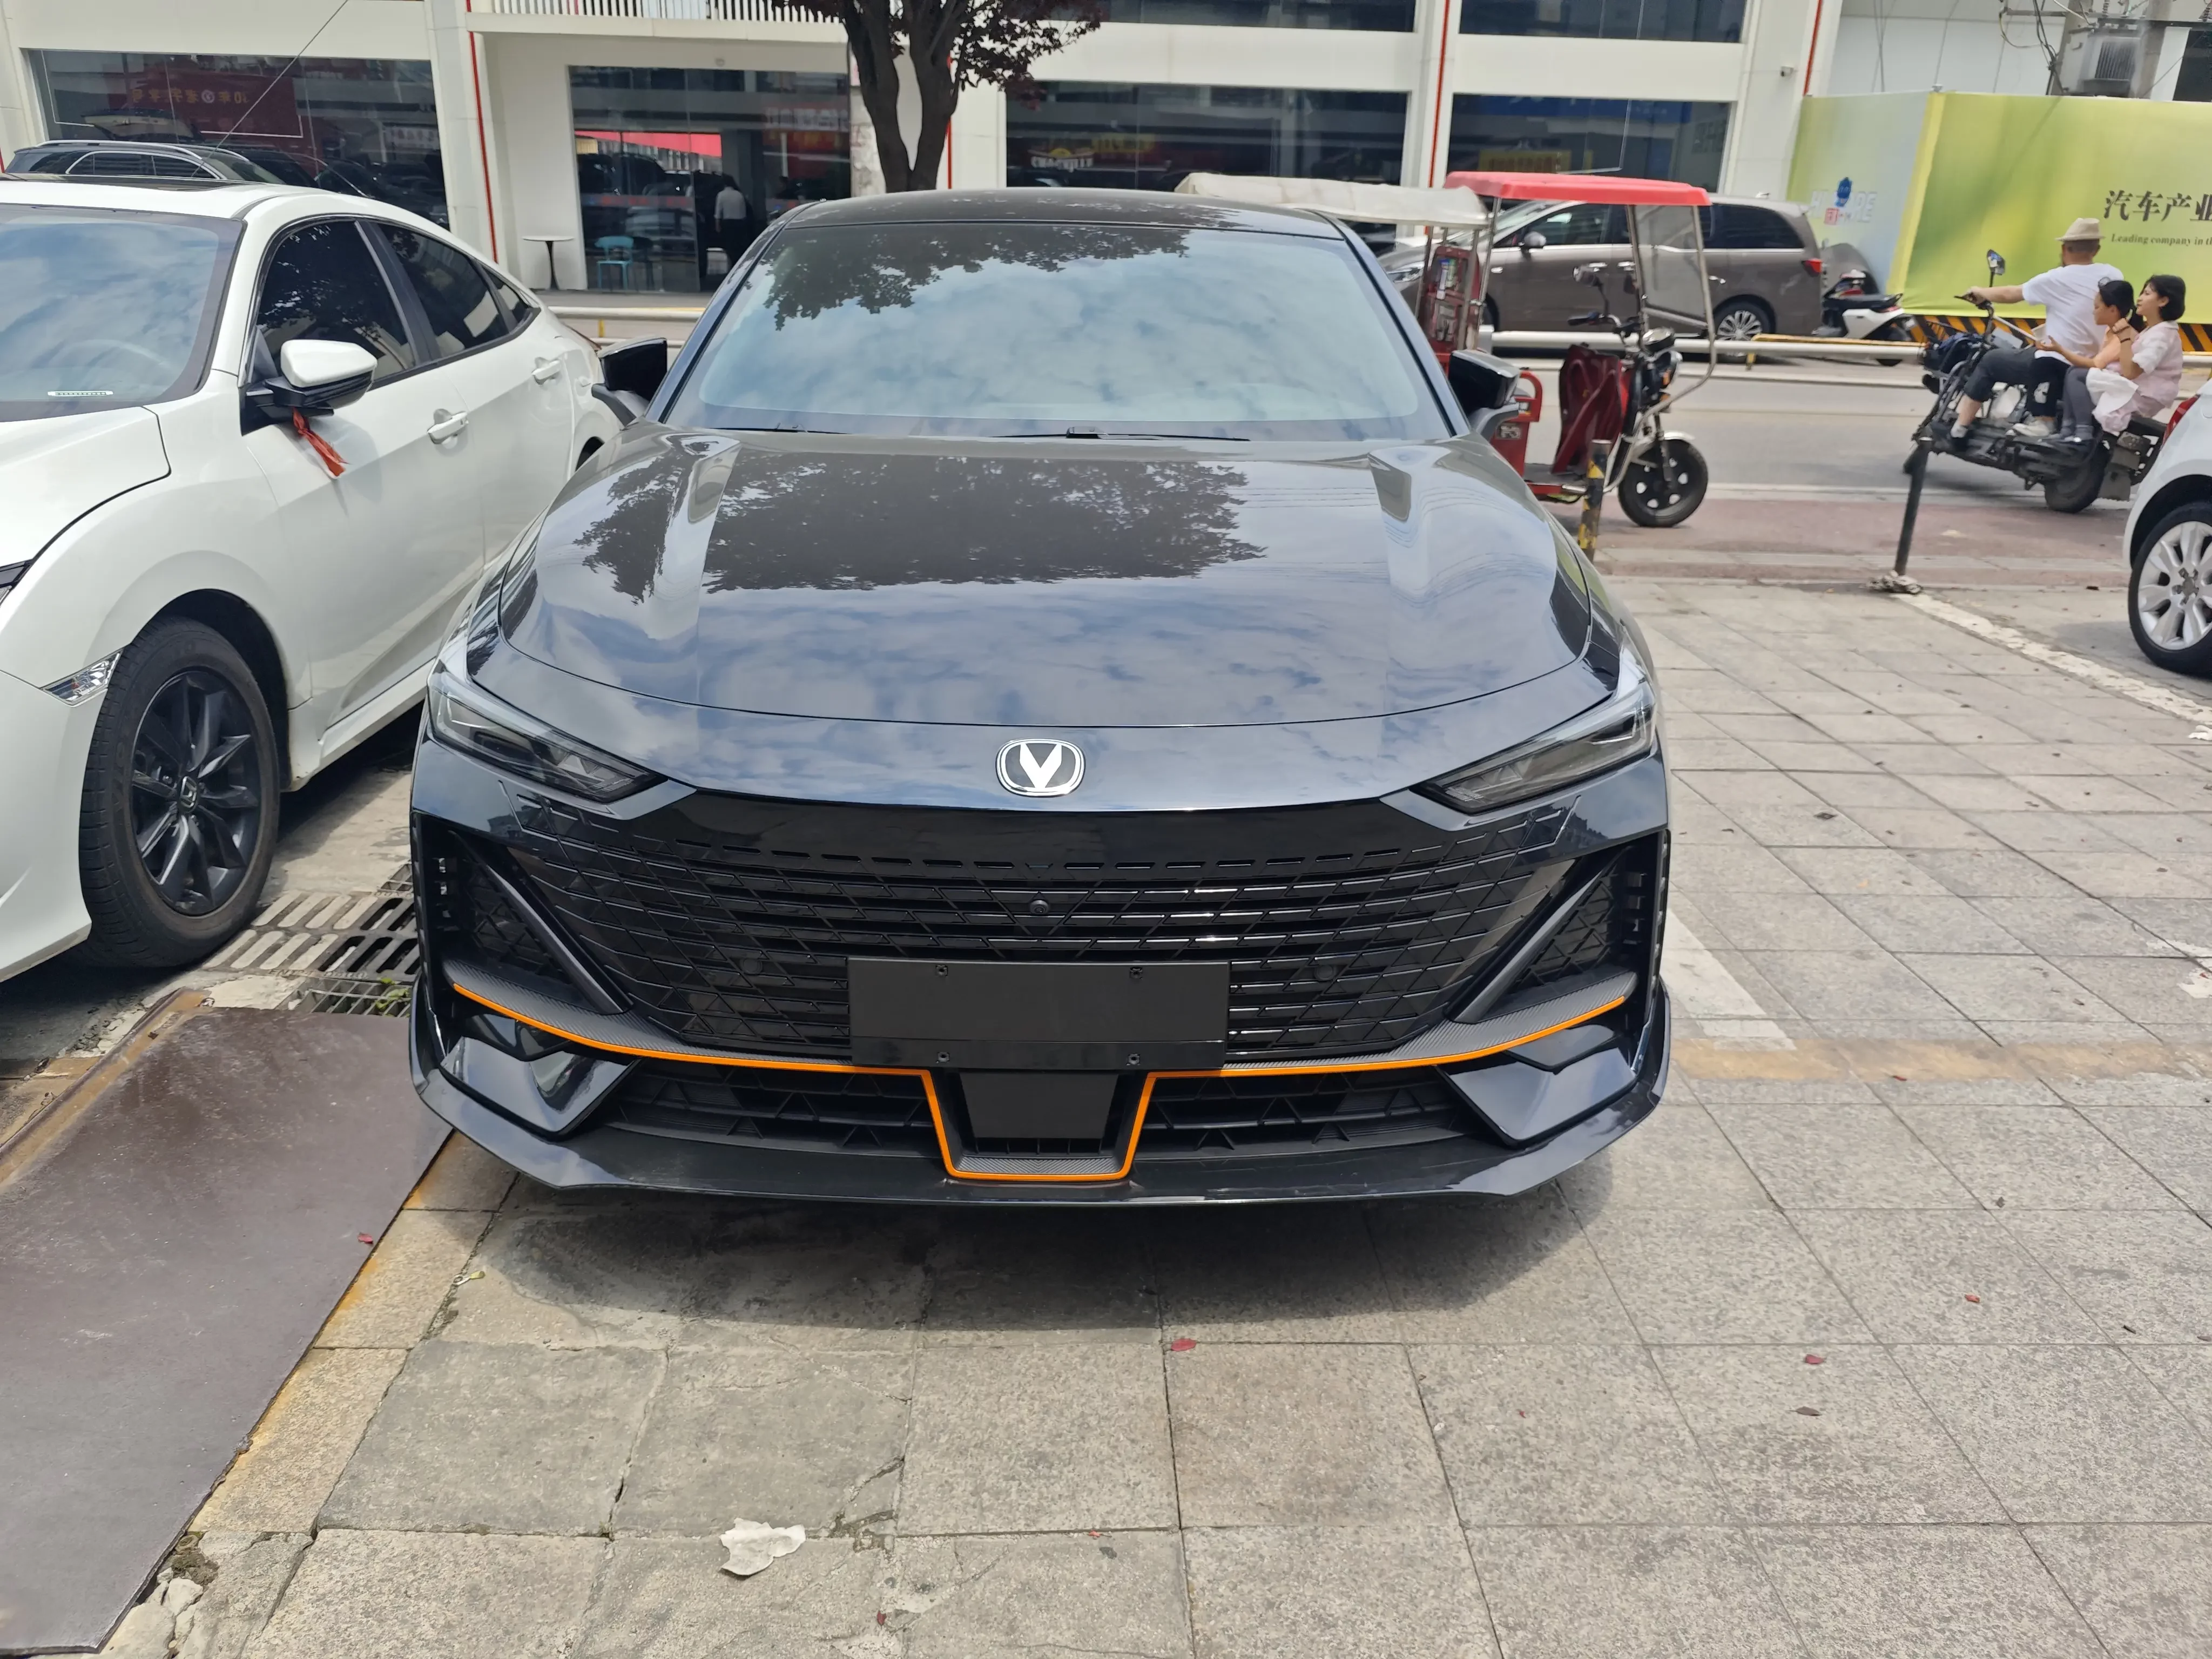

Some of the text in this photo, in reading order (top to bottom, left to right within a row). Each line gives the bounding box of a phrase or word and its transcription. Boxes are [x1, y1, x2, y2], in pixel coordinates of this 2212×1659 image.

[2103, 190, 2212, 222] 汽车产业
[2111, 233, 2149, 245] Leading
[2150, 237, 2191, 247] company
[2194, 236, 2203, 246] in
